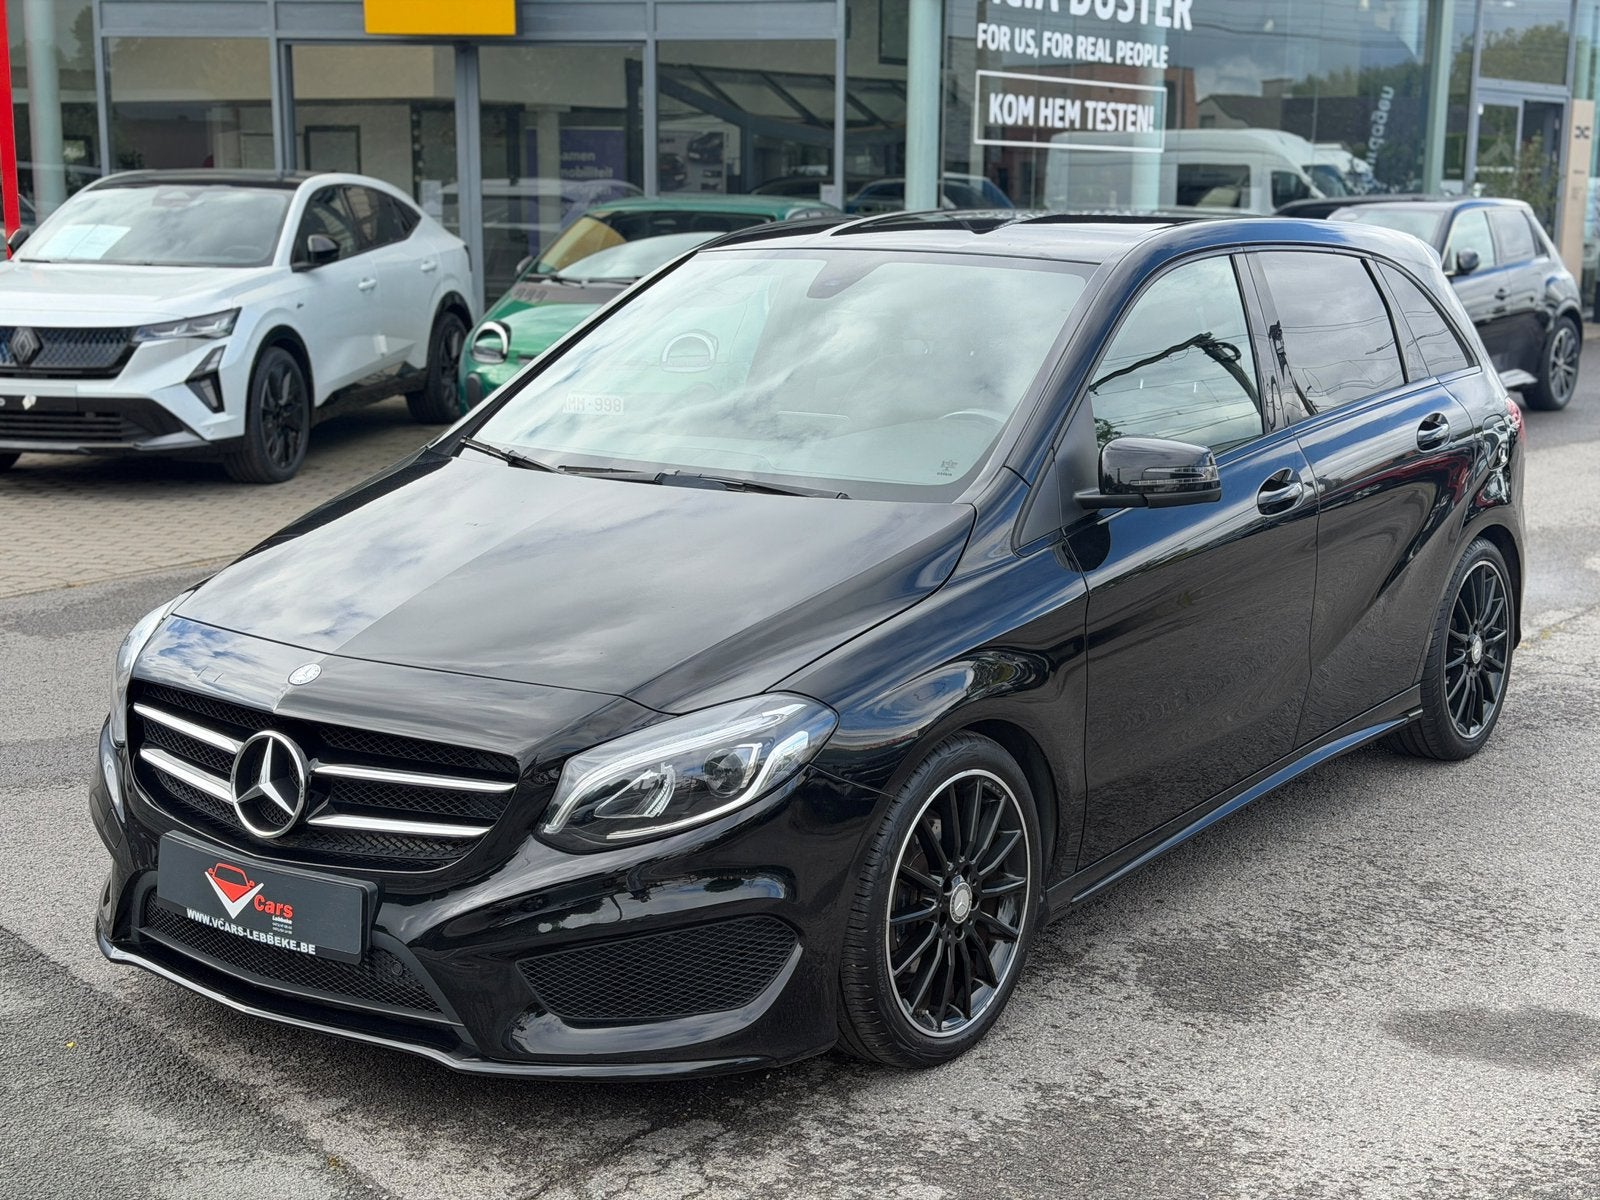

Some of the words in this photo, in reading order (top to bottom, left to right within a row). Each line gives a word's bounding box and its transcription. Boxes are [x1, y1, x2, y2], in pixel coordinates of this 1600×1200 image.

[977, 22, 1011, 52] FOR
[1014, 27, 1039, 59] US,
[1042, 30, 1073, 59] FOR
[1076, 34, 1114, 64] REAL
[1115, 39, 1169, 69] PEOPLE
[989, 93, 1035, 125] KOM
[1038, 97, 1081, 129] HEM
[1084, 100, 1155, 133] TESTEN!
[254, 894, 294, 919] Cars
[186, 907, 316, 956] WWW.VCARS-LEBBEKE.BE
